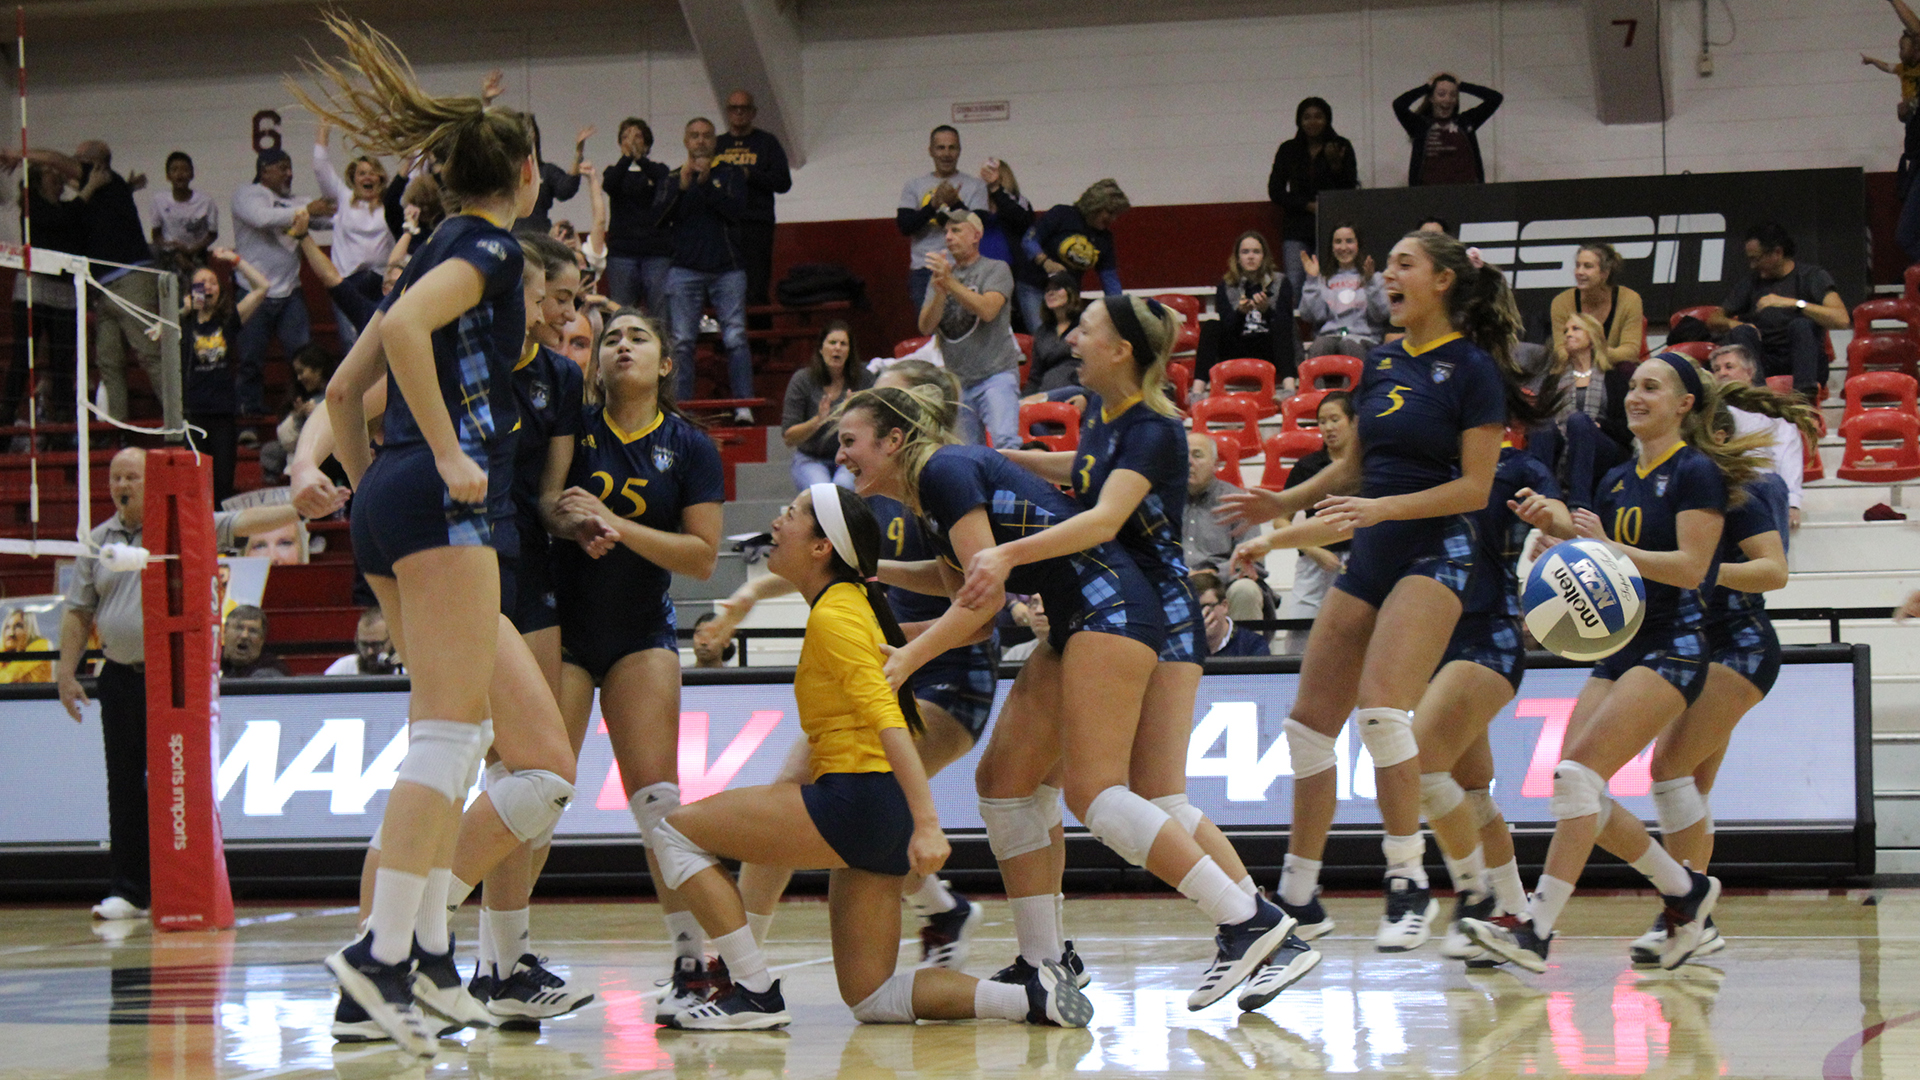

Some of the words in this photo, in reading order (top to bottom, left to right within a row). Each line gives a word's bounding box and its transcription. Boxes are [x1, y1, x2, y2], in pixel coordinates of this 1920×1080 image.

[1611, 19, 1638, 49] 7
[252, 109, 282, 153] 6
[1458, 212, 1727, 290] ESPN
[1375, 384, 1413, 418] 5
[590, 470, 650, 519] 25
[1079, 454, 1097, 494] 3
[886, 516, 905, 557] 9
[1614, 506, 1643, 546] 10
[1553, 567, 1599, 628] molten
[1569, 557, 1616, 610] NCAA
[168, 733, 187, 786] sports
[170, 786, 188, 851] imports
